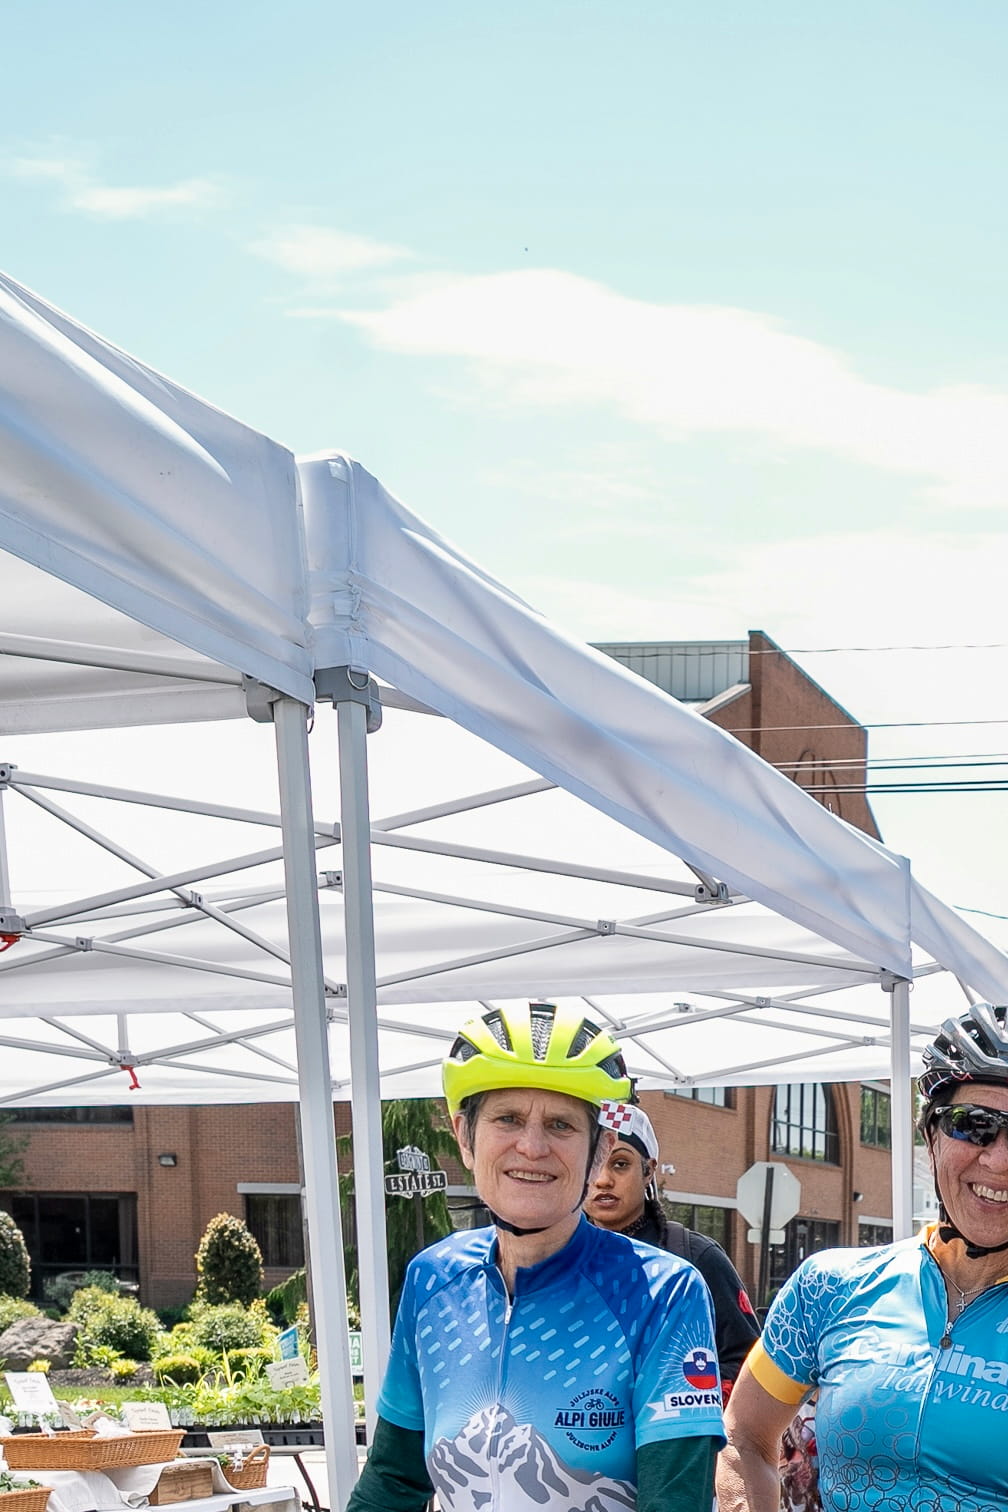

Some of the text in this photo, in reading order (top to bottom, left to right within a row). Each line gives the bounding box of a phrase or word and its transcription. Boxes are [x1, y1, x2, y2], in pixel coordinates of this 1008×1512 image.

[670, 1394, 722, 1407] SLOVEN
[554, 1411, 625, 1427] ALPI GIULIE
